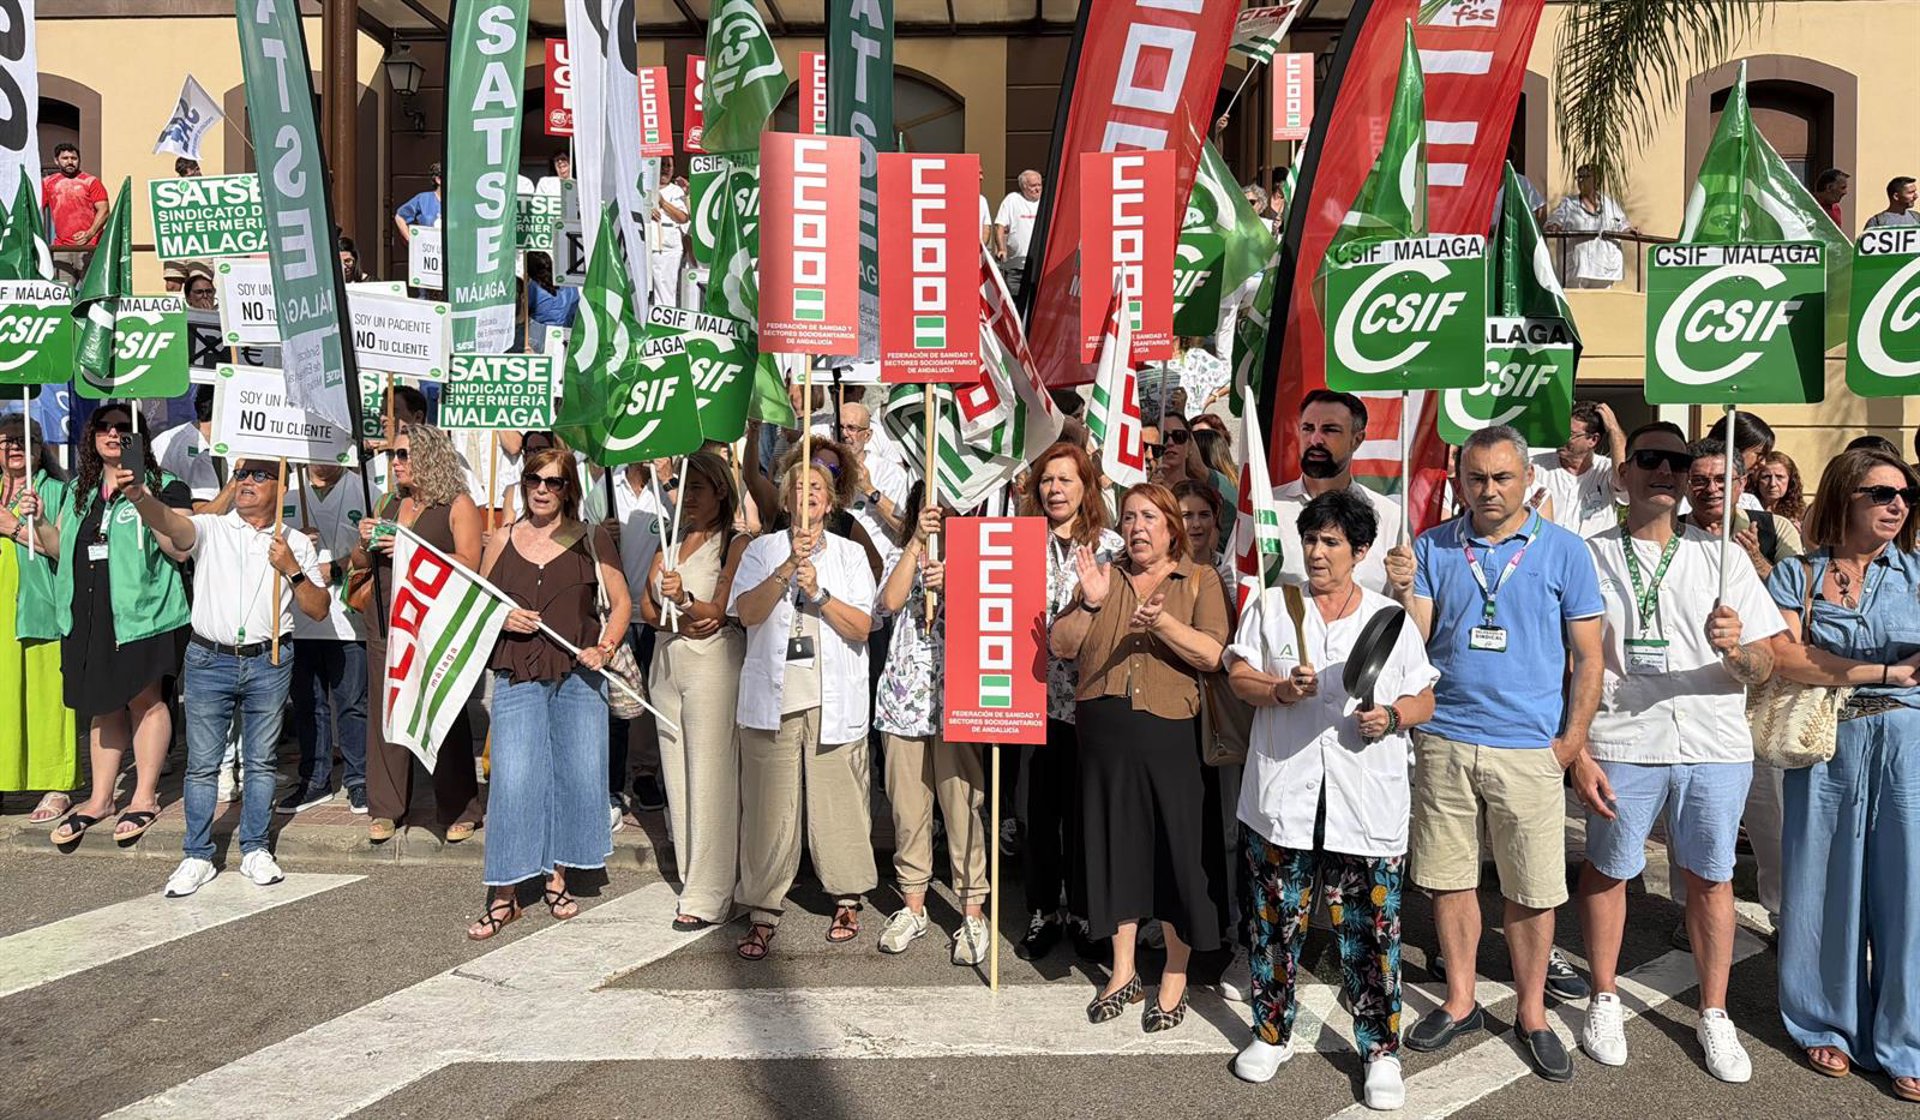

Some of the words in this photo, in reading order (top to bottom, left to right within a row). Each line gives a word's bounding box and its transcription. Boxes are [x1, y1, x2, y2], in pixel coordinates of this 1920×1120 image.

[1452, 5, 1495, 26] fss
[1286, 54, 1301, 113] CCOO
[640, 69, 659, 129] CCOO
[472, 5, 517, 275] SATSE
[693, 156, 722, 172] CSIF
[158, 206, 247, 222] SINDICATO
[251, 204, 263, 217] D
[793, 138, 828, 285] CCOO
[160, 217, 267, 235] ENFERMERI
[911, 158, 947, 312] CCOO
[1112, 155, 1145, 298] CCOO
[1336, 243, 1382, 265] CSIF
[1394, 237, 1481, 261] MALAGA
[1859, 231, 1918, 255] CSIF
[423, 256, 439, 271] NO
[1656, 246, 1709, 266] CSIF
[1723, 244, 1819, 265] MALAGA
[15, 283, 73, 301] MÁLAGA
[237, 283, 256, 296] SOY
[456, 280, 507, 303] MÁLAGA
[120, 299, 182, 312] MALAGA
[242, 301, 264, 321] NO
[355, 312, 372, 328] SOY
[373, 316, 386, 329] UN
[388, 317, 432, 335] PACIENTE
[651, 306, 688, 327] CSIF
[695, 314, 737, 338] MALA
[766, 322, 808, 330] FEDERACIÓN
[819, 324, 847, 332] SANIDAD
[356, 329, 376, 350] NO
[378, 339, 390, 352] TU
[391, 341, 429, 357] CLIENTE
[796, 338, 834, 346] ANDALUCÍA
[887, 351, 929, 359] FEDERACIÓN
[451, 356, 550, 383] SATSE
[917, 366, 955, 374] ANDALUCÍA
[239, 390, 263, 405] SOY
[265, 393, 281, 408] UN
[446, 383, 524, 395] SINDICATO
[527, 384, 547, 395] DE
[445, 395, 547, 407] ENFERMERIA
[240, 409, 266, 432] NO
[270, 419, 284, 435] TU
[287, 422, 332, 439] CLIENTE
[444, 406, 547, 427] MALAGA
[979, 522, 1013, 670] CCOO
[431, 646, 458, 689] málaga
[952, 710, 993, 718] FEDERACIÓN
[1005, 711, 1034, 719] SANIDAD
[981, 726, 1019, 734] ANDALUCÍA
